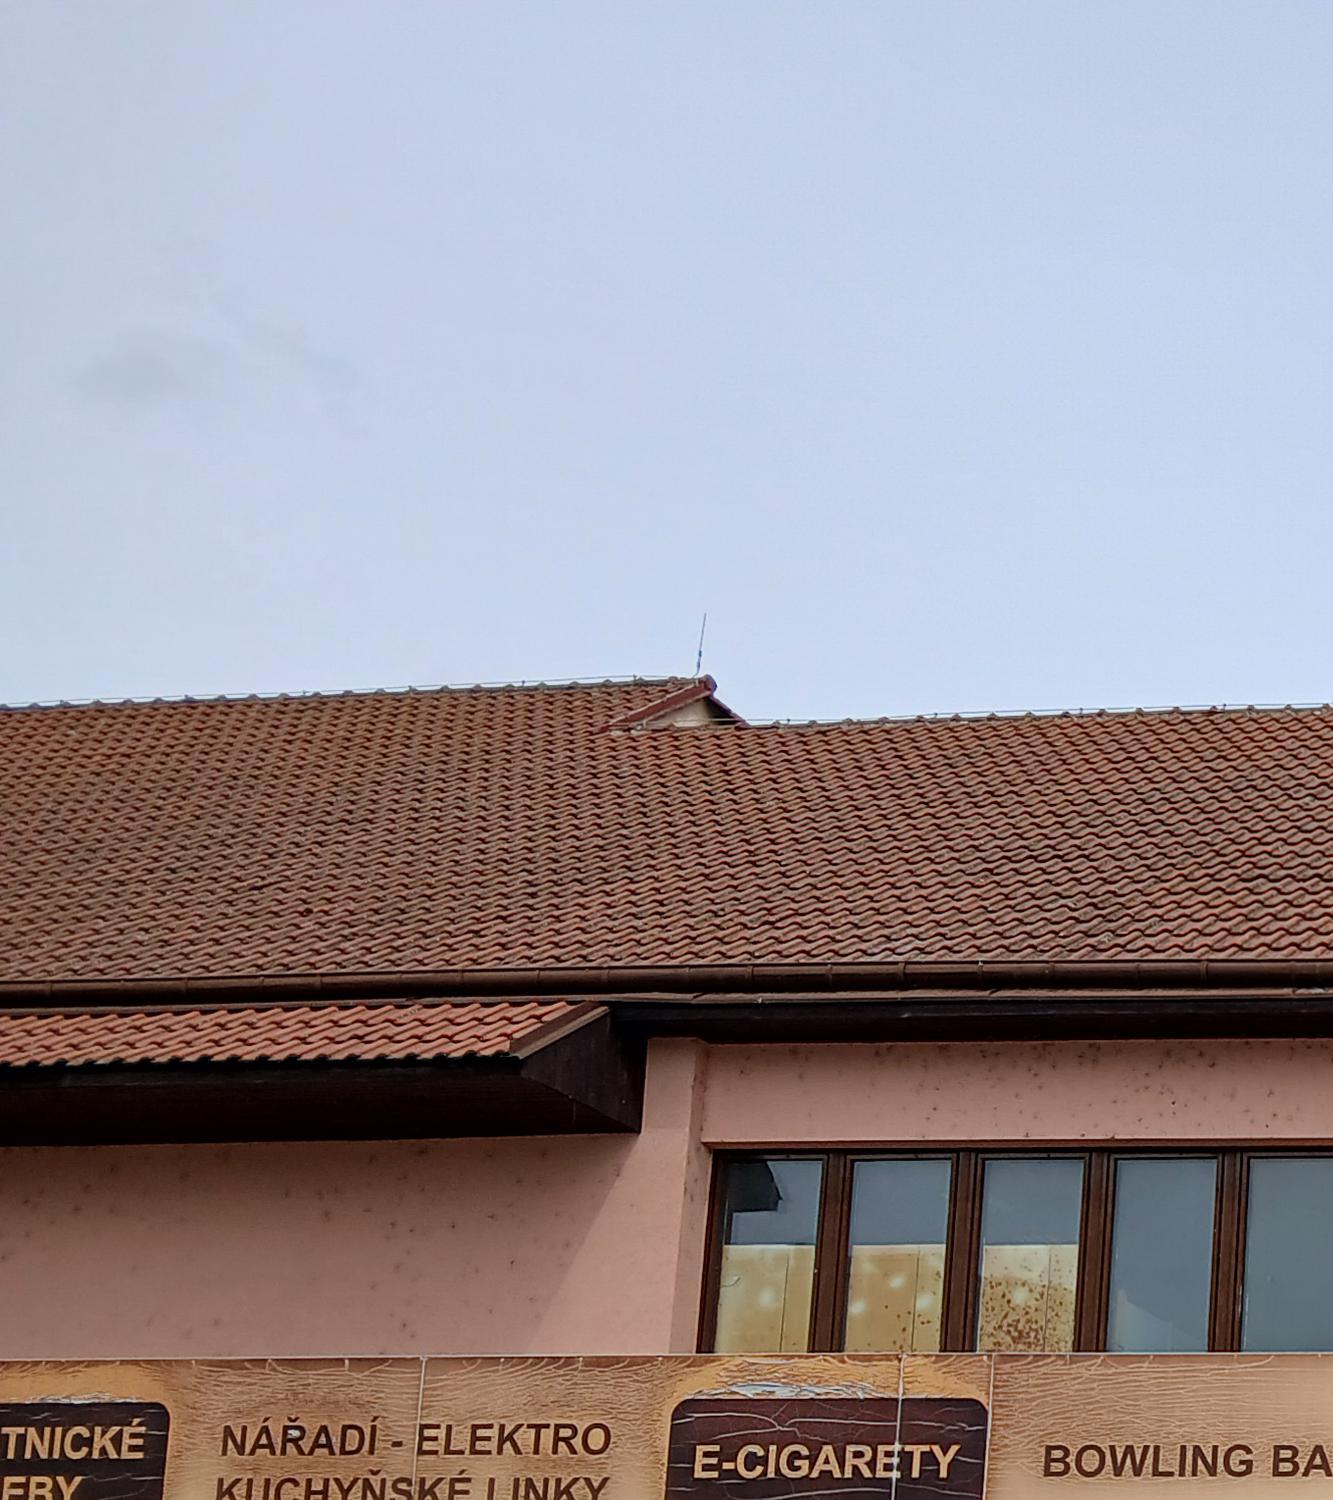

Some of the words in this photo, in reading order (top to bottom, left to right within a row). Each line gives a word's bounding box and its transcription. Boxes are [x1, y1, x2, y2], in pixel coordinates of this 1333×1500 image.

[220, 1416, 379, 1457] NÁŘADÍ
[417, 1422, 612, 1456] ELEKTRO
[692, 1444, 961, 1480] E-CIGARETY
[1042, 1444, 1255, 1479] BOWLING
